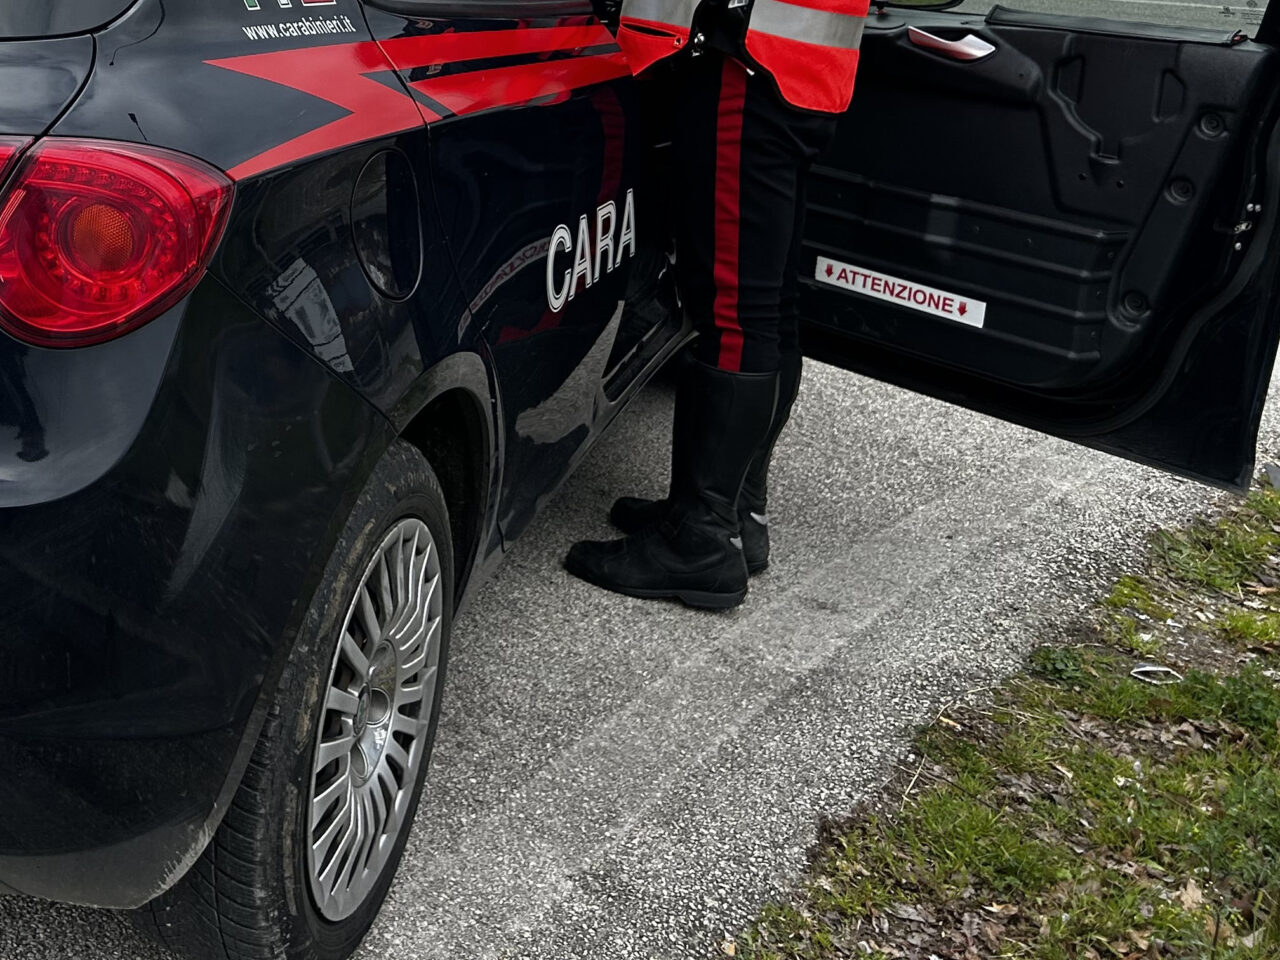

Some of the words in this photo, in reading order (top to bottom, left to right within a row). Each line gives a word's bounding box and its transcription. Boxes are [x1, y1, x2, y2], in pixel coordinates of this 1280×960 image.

[242, 16, 356, 40] www.carabinieri.it
[546, 188, 636, 313] CARA
[836, 268, 955, 314] ATTENZIONE
